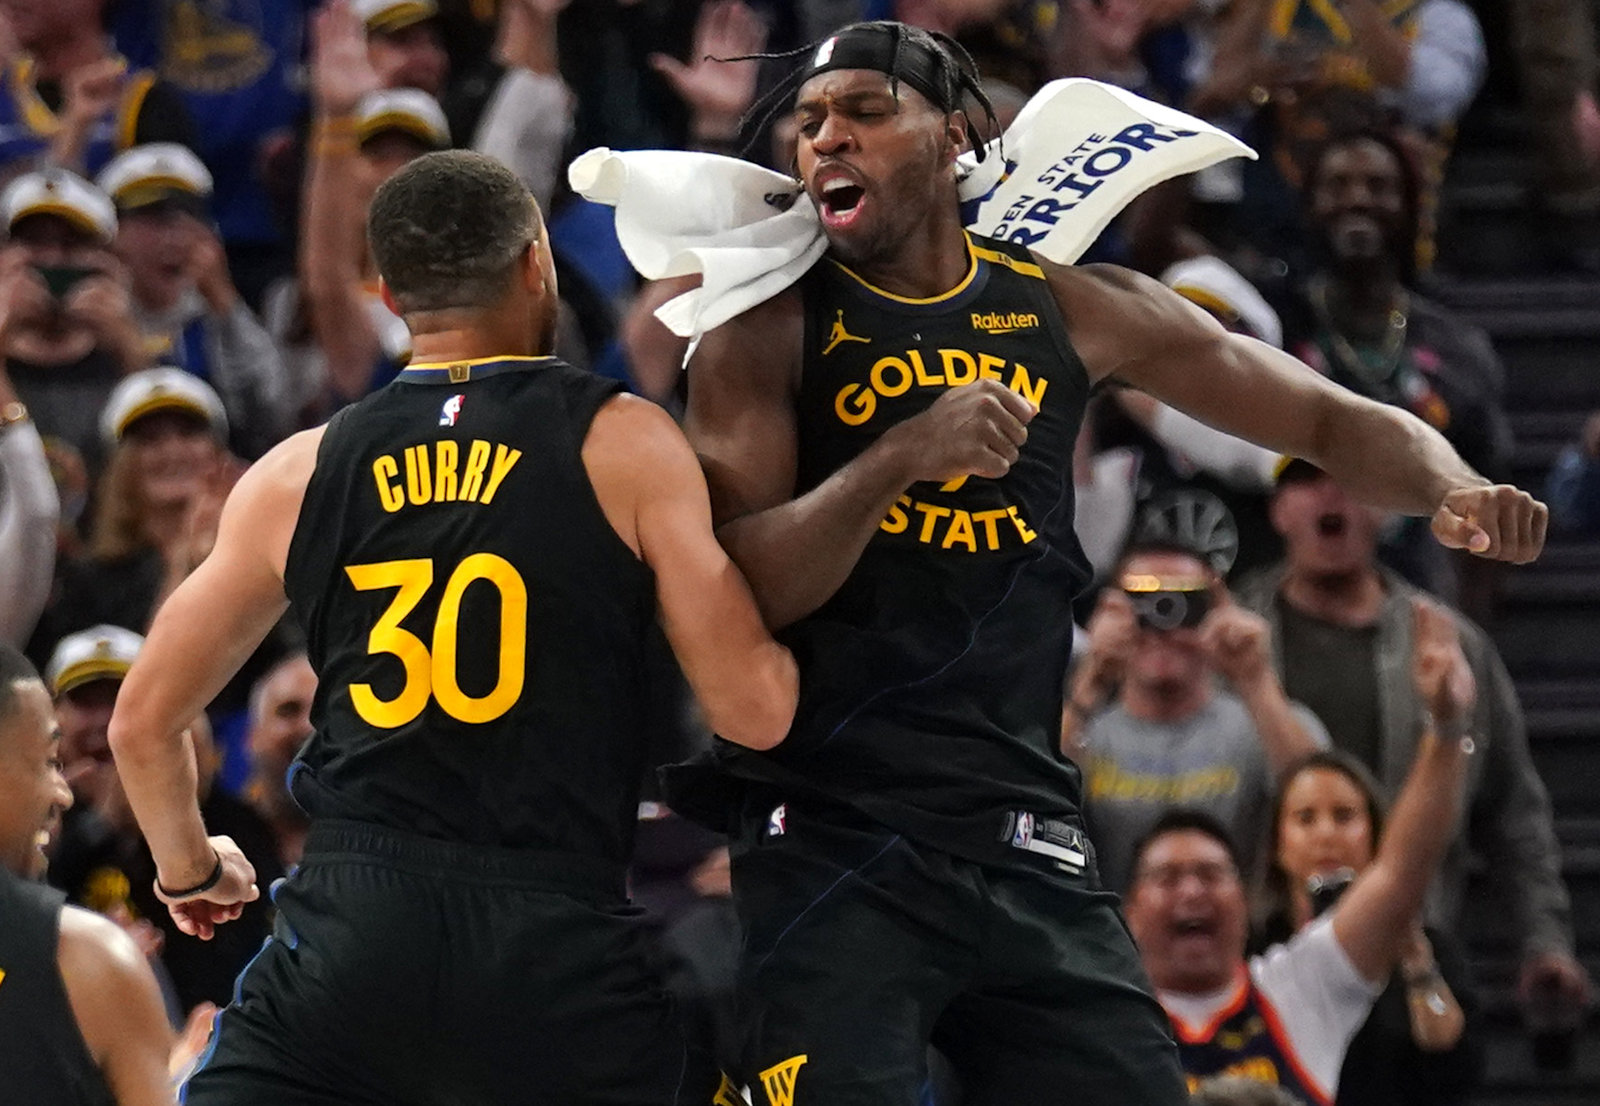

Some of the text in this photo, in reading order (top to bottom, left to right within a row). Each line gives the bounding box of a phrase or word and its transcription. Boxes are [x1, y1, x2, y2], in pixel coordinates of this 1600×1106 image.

[1008, 123, 1199, 246] RRIOR
[1037, 133, 1106, 185] STATE
[971, 312, 1039, 334] Rakuten
[834, 349, 1048, 426] GOLDEN
[373, 439, 522, 513] CURRY
[879, 495, 1038, 553] STATE
[344, 552, 527, 728] 30
